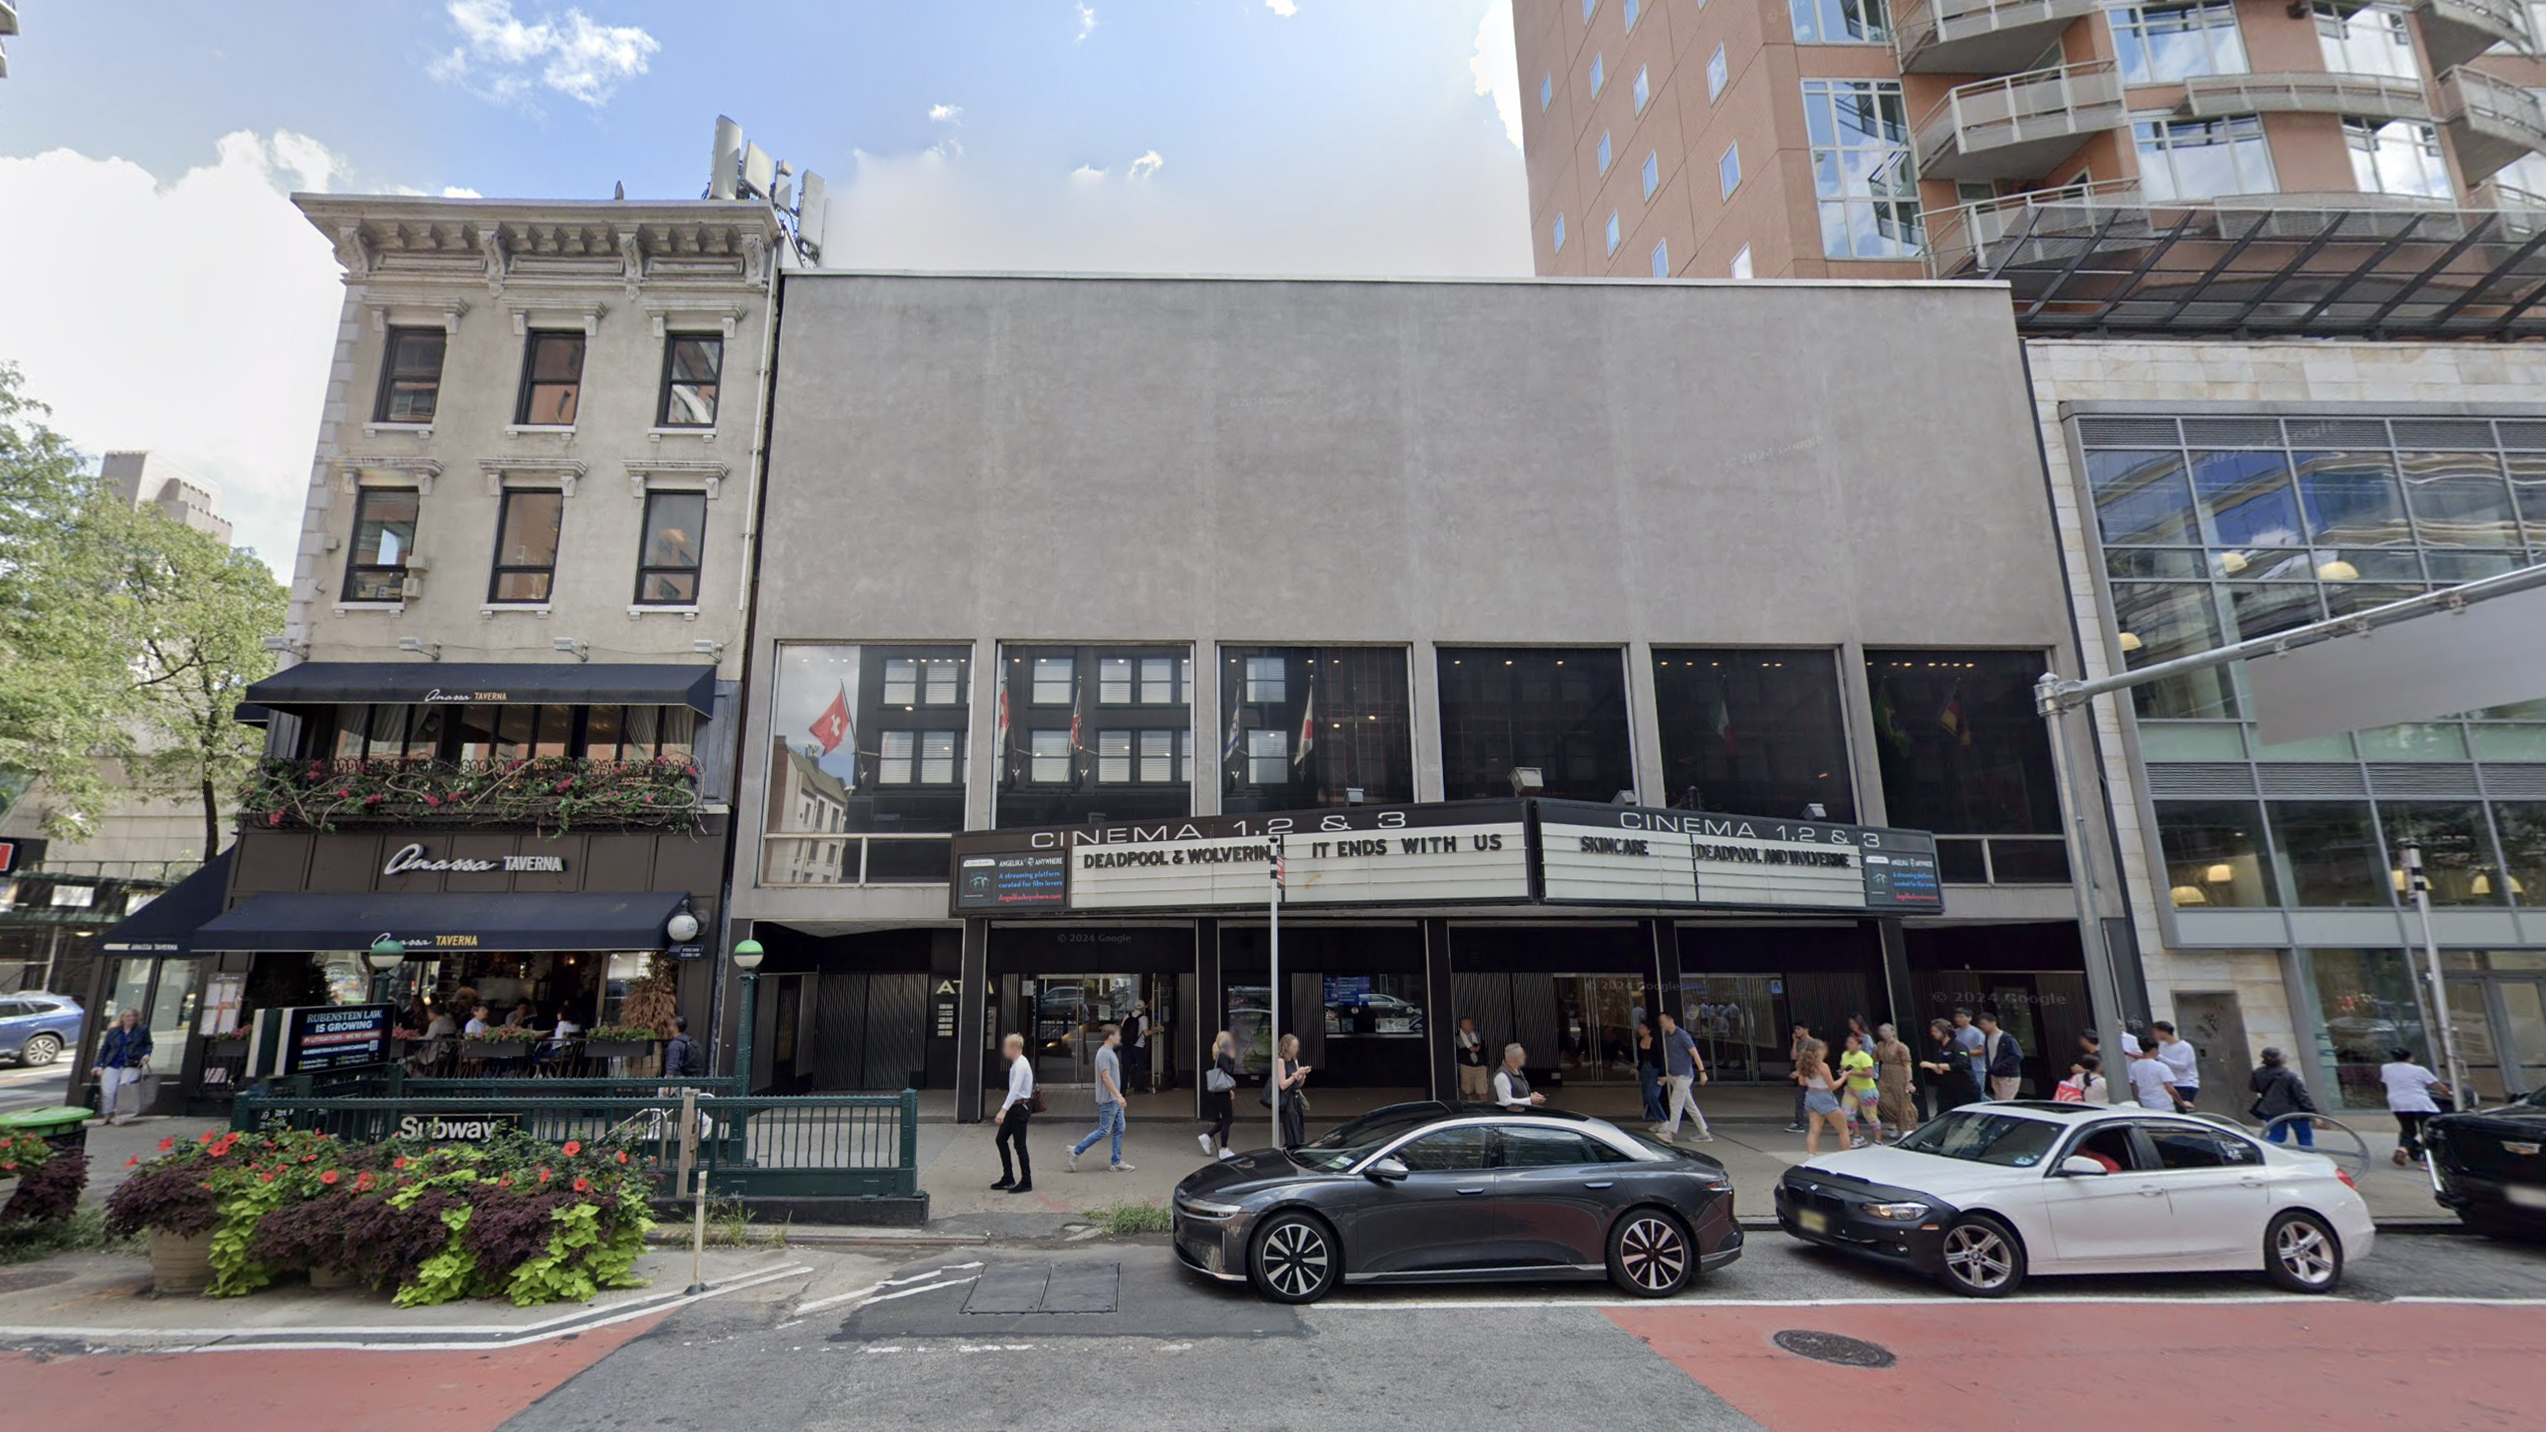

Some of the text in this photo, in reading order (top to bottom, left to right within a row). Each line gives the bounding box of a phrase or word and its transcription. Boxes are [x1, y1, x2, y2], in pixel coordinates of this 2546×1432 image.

[425, 688, 507, 702] Anassa TAVERNA
[1031, 811, 1407, 848] CINEMA 1,2 & 3
[1619, 811, 1881, 848] CINEMA 1,2 & 3
[1312, 833, 1503, 858] IT ENDS WITH US
[1580, 835, 1649, 856] SKINCARE
[383, 843, 563, 875] Anassa TAVERNA
[998, 859, 1024, 868] ANGELIKA
[1034, 857, 1063, 866] ANYWHERE
[1083, 844, 1281, 869] DEADPOOL & WOLVERIN
[1695, 843, 1851, 868] DEADPOOL AND WOLVERINE
[1005, 871, 1034, 880] streaming
[1034, 870, 1061, 879] platform
[998, 880, 1021, 889] curated
[1045, 879, 1063, 887] lovers
[998, 892, 1062, 903] AngelikaAnywhere.com
[435, 935, 478, 947] TAVERNA
[307, 1012, 362, 1023] RUBENSTEIN
[315, 1020, 373, 1033] IS GROWING
[401, 1116, 497, 1143] Subway
